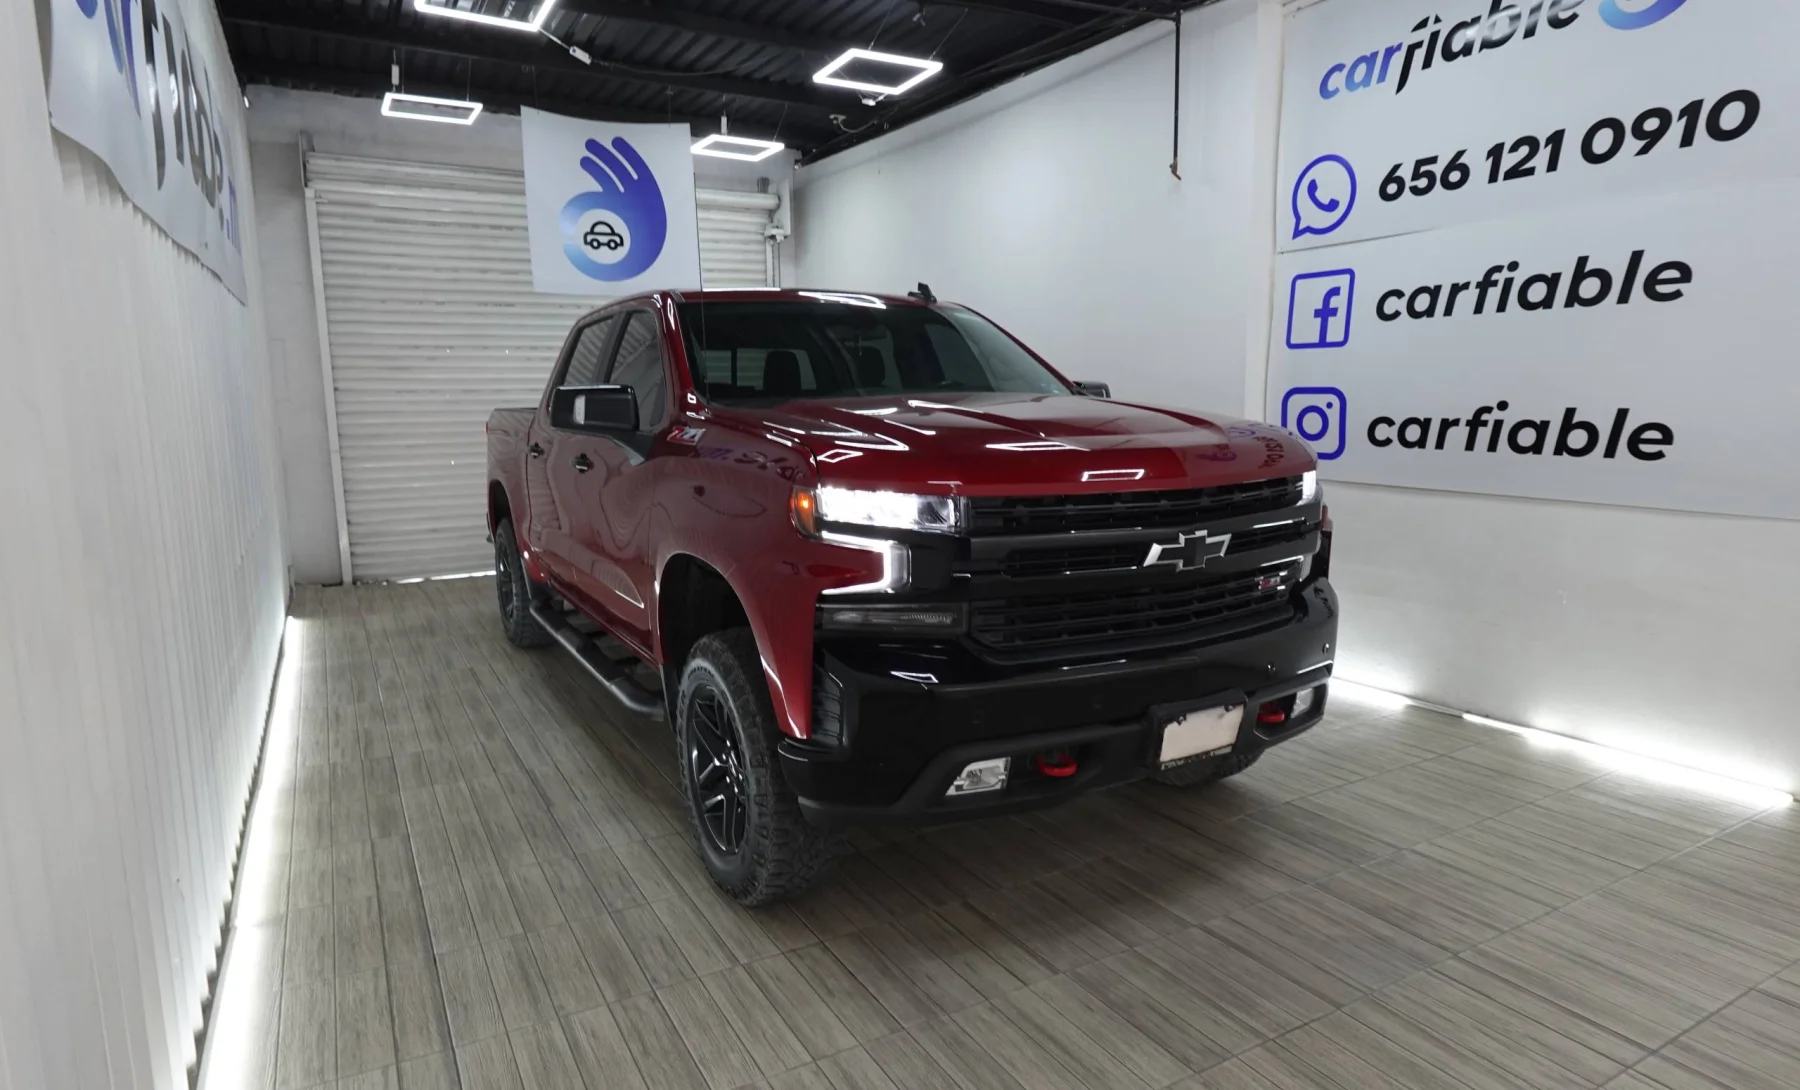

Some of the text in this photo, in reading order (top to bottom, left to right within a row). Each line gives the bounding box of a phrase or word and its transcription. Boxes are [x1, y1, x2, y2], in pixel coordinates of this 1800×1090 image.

[1379, 89, 1761, 203] 656 121 0910
[1376, 249, 1693, 322] carfiable
[1367, 400, 1675, 461] carfiable
